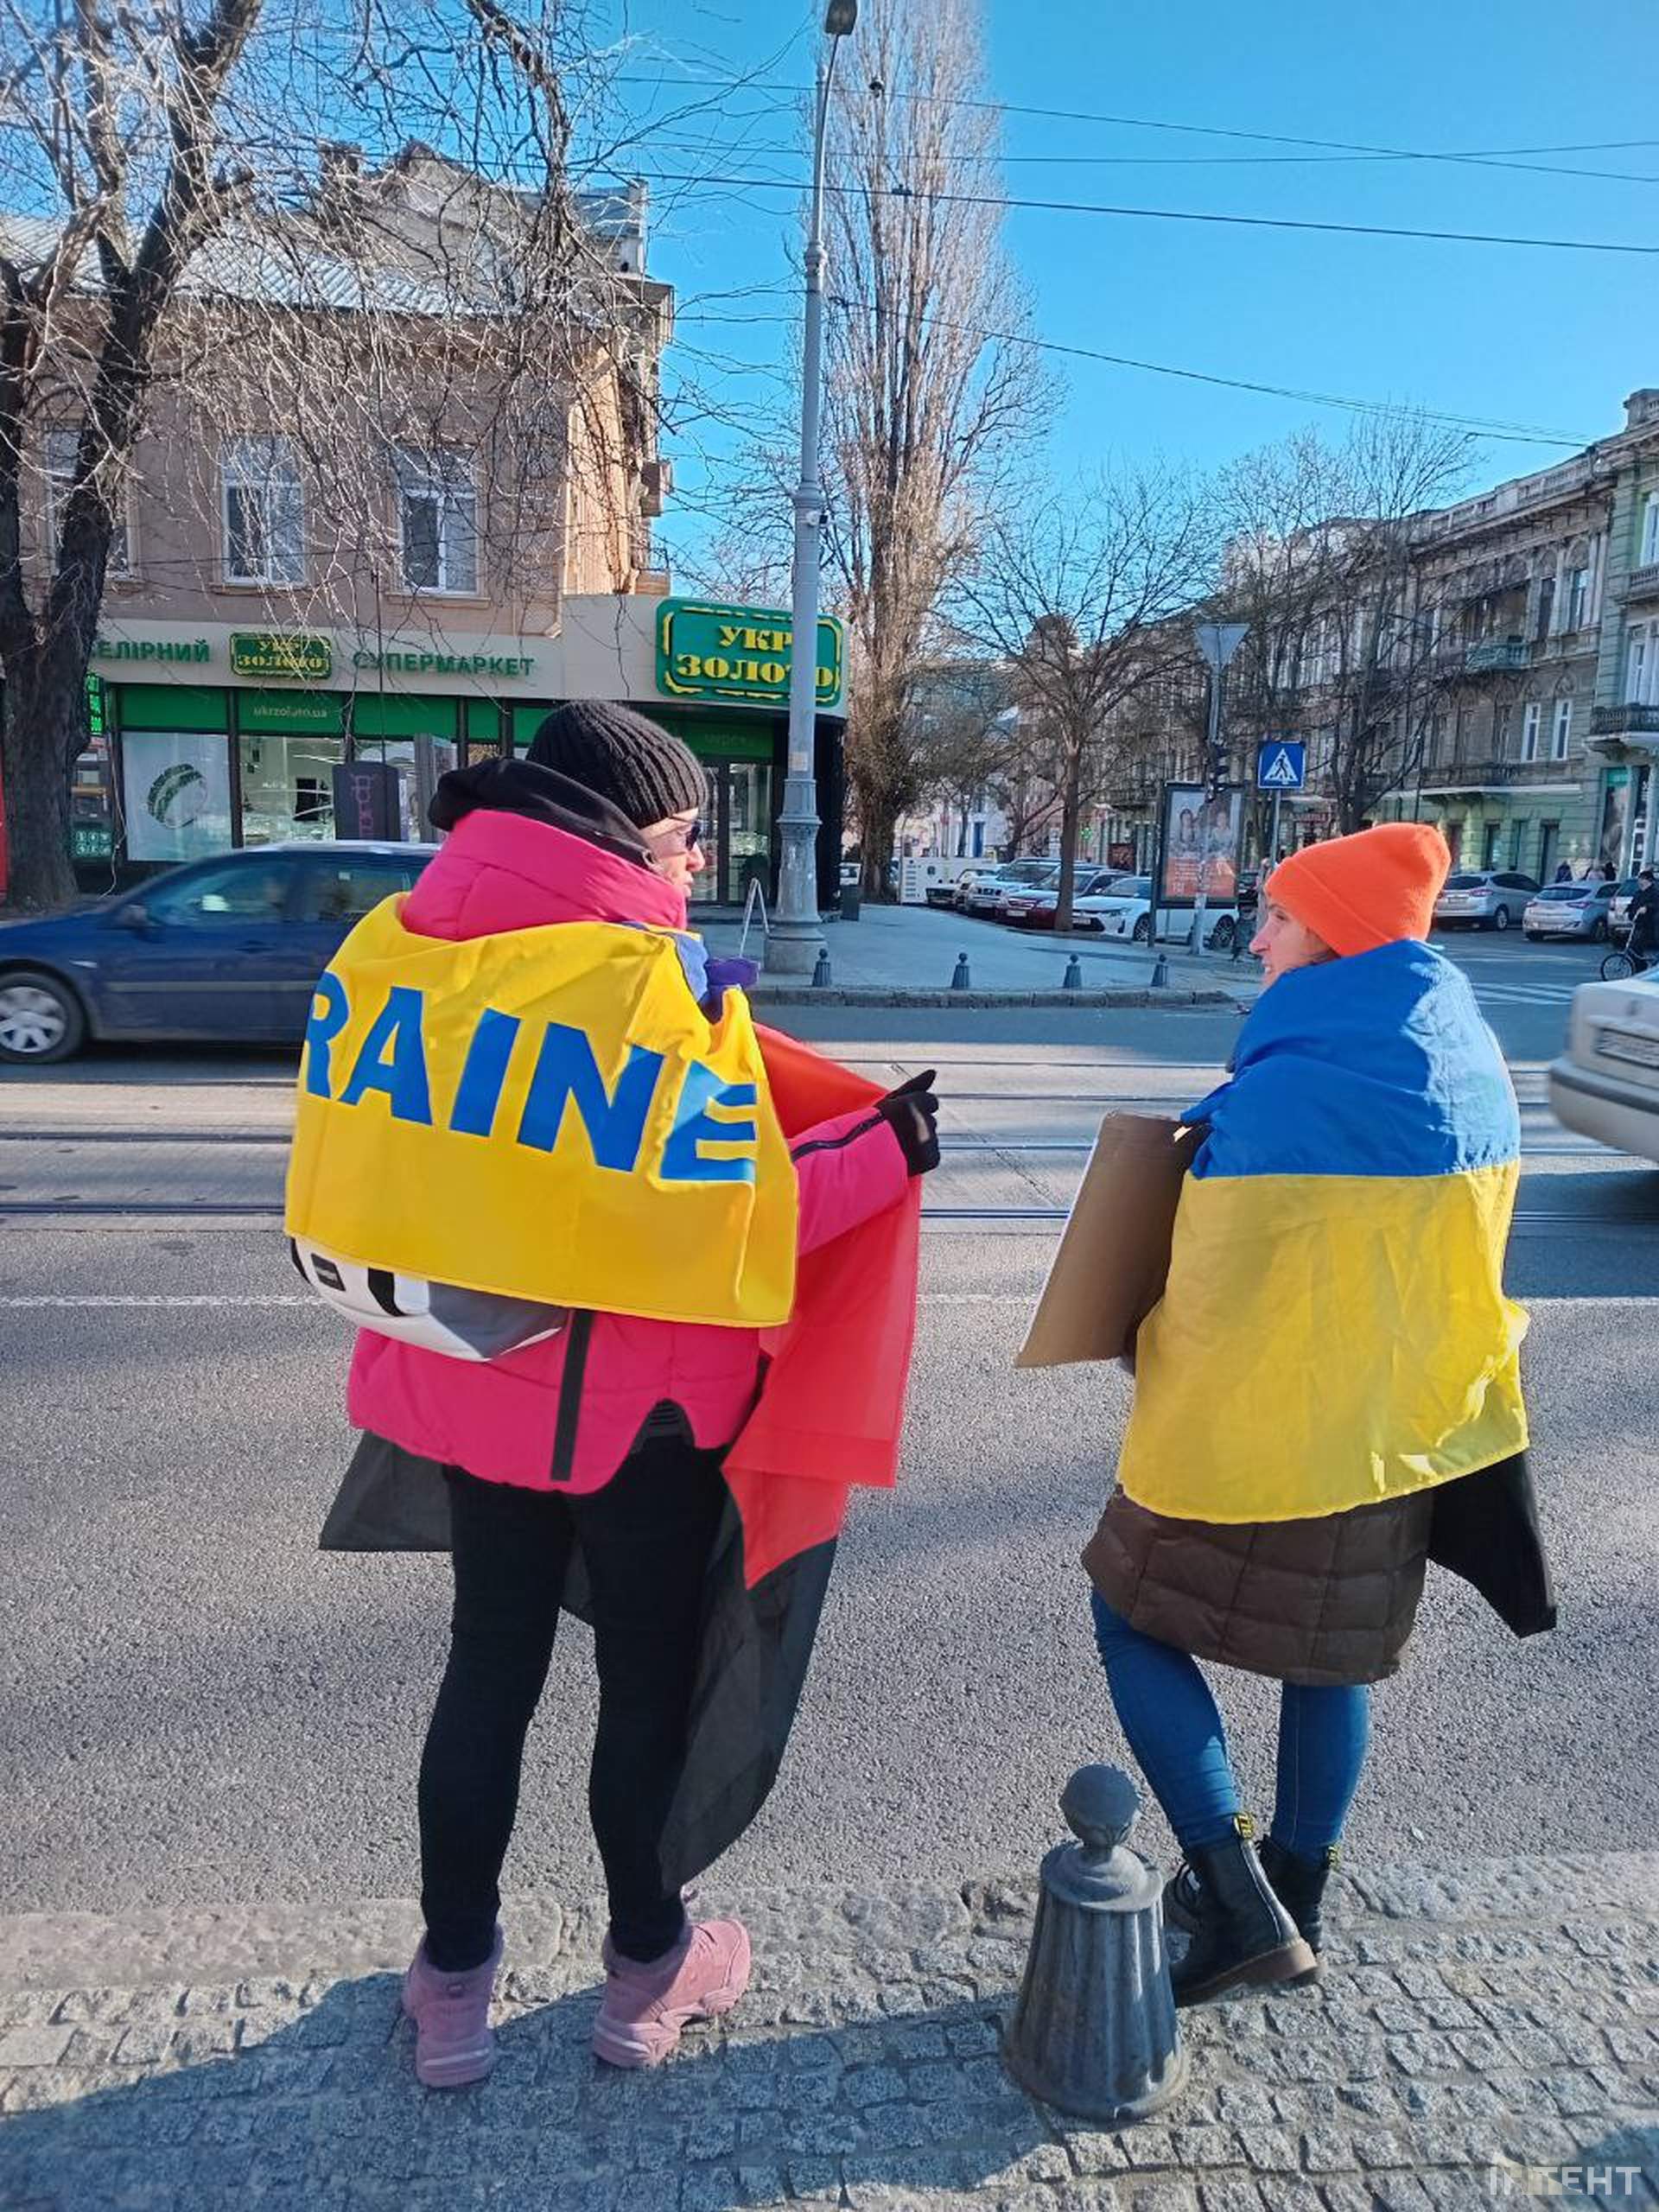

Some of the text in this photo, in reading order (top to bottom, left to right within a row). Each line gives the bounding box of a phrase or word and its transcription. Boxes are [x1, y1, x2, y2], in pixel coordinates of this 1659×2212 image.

[91, 638, 210, 663] ЕЛІРНИЙ
[718, 625, 792, 652] УКР
[353, 650, 535, 677] СУПЕРМАРКЕТ
[676, 654, 834, 688] ЗОЛОО
